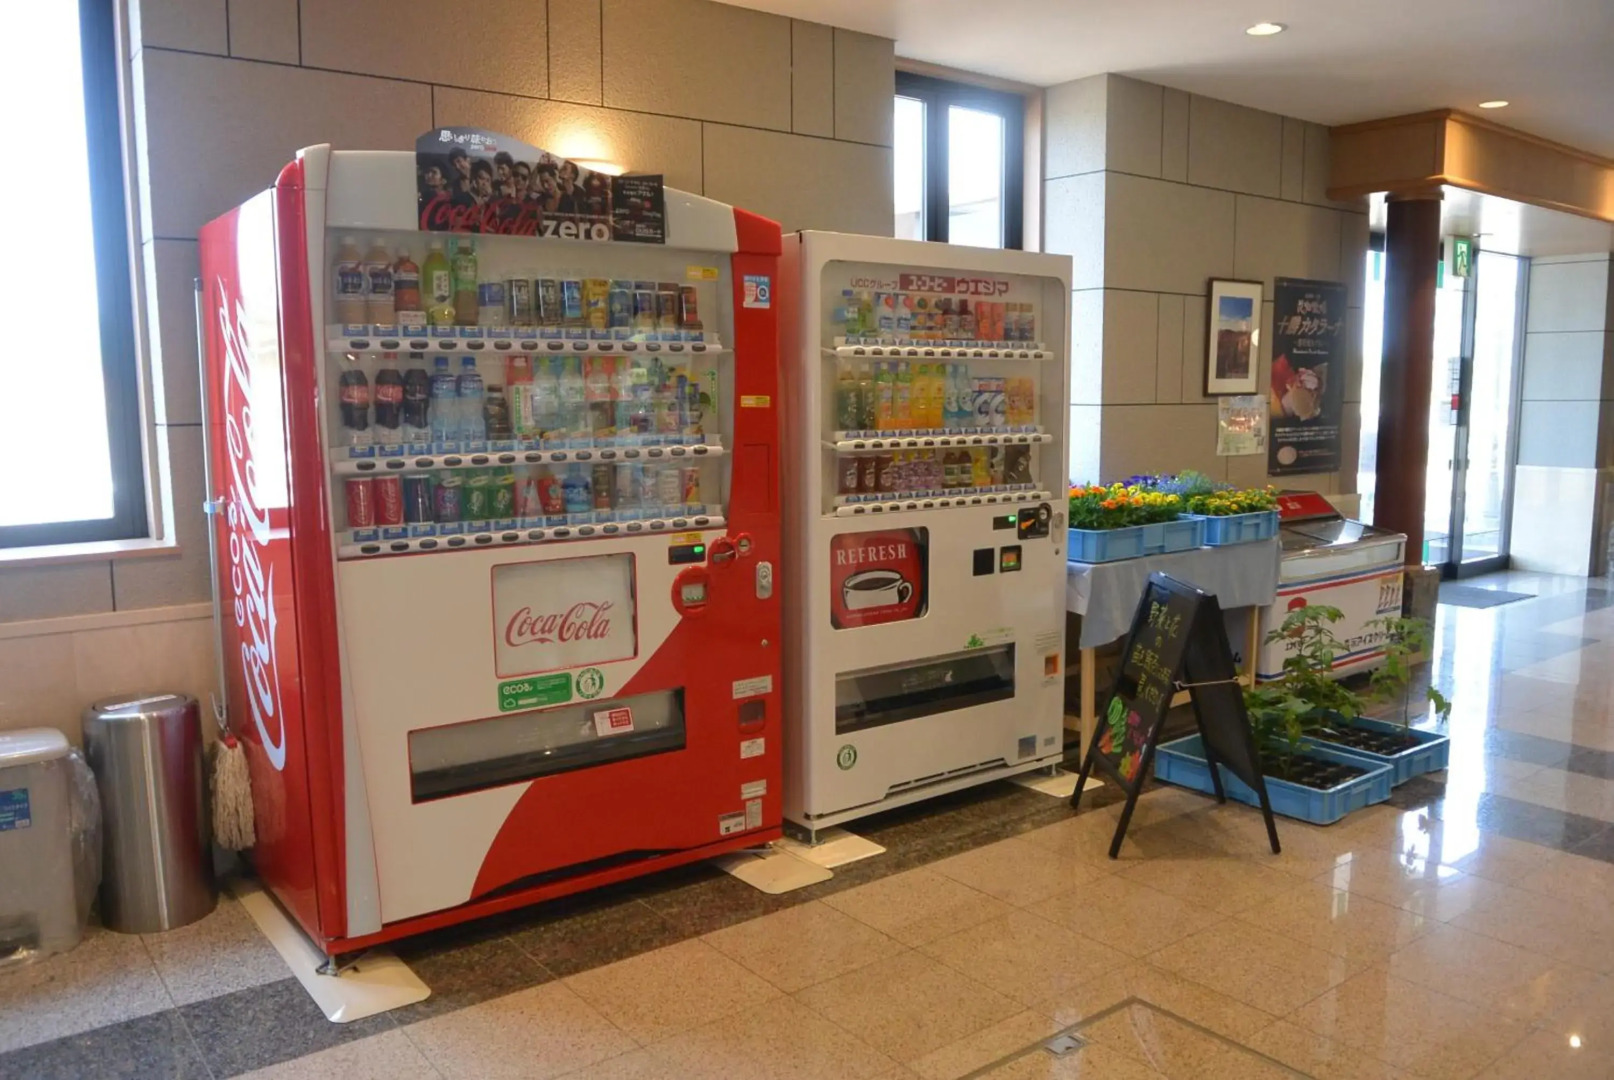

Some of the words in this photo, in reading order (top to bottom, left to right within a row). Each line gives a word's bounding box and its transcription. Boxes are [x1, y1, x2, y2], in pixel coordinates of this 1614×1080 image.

[542, 219, 610, 241] zero
[836, 543, 907, 566] REFRESH
[505, 601, 614, 647] Coca-Cola
